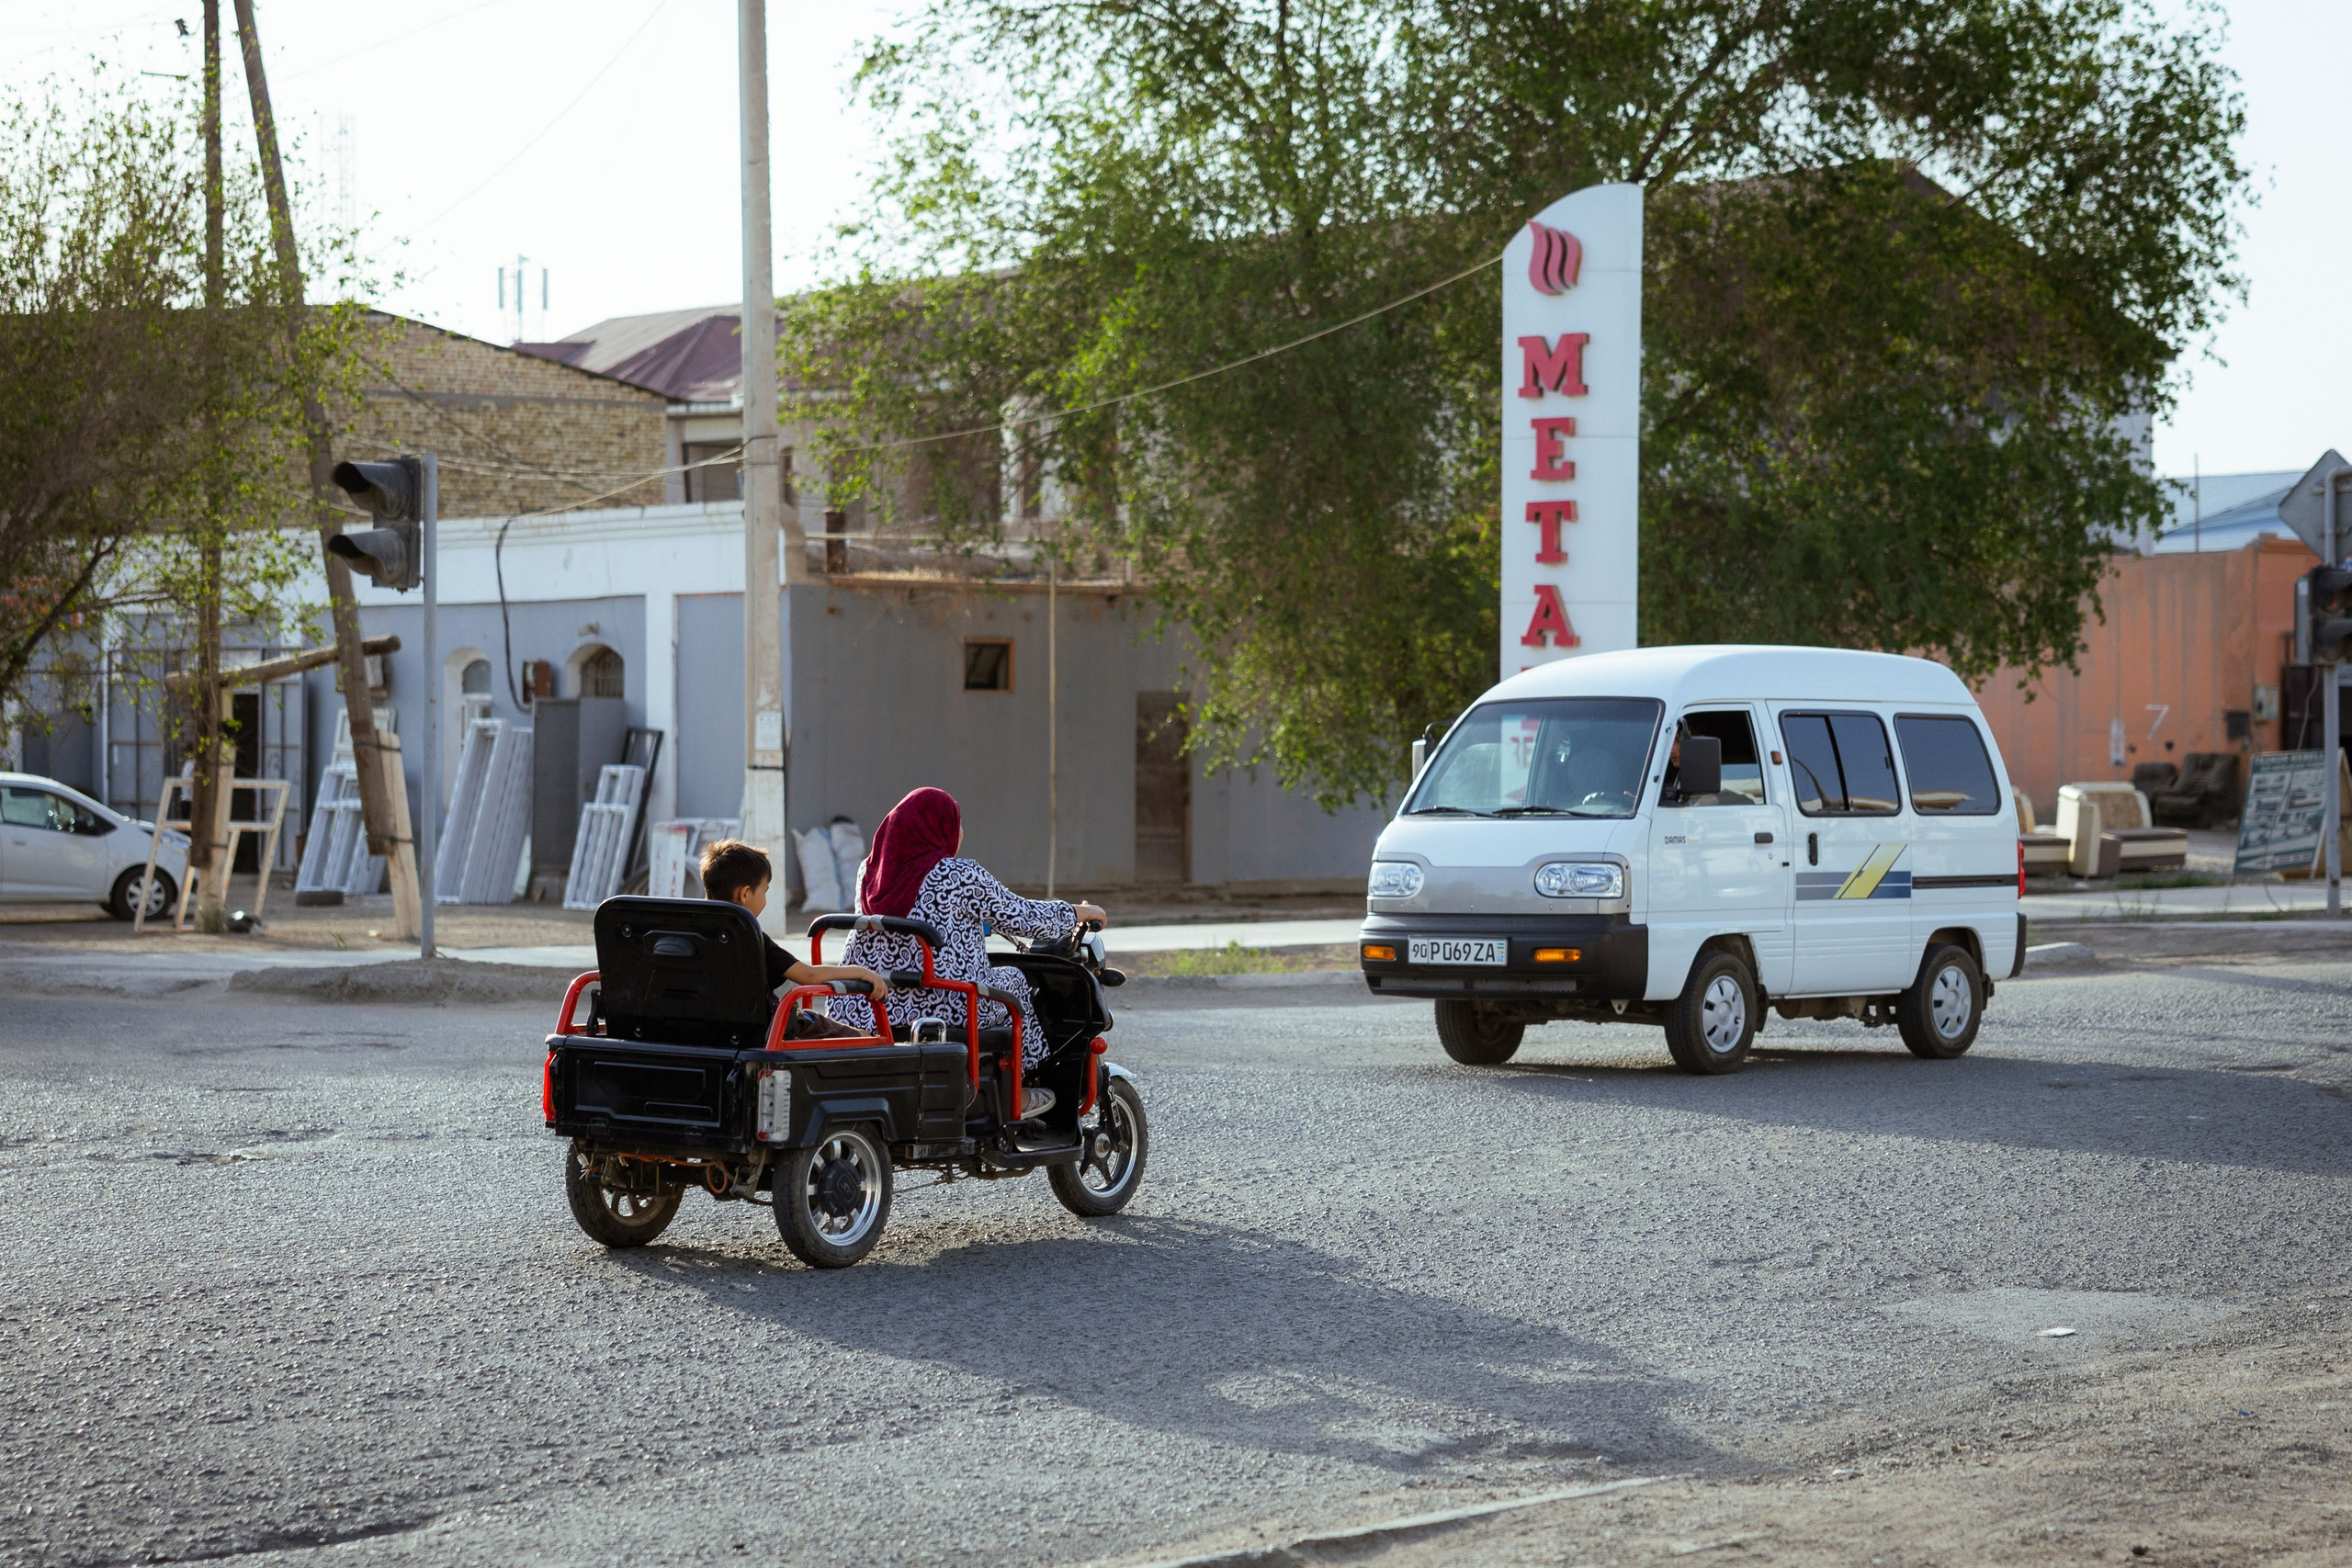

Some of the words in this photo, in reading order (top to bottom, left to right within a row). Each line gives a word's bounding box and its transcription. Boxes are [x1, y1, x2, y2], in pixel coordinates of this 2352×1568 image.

[1517, 332, 1589, 673] META
[2145, 703, 2169, 741] 7
[1664, 835, 1687, 845] DAMAS
[1412, 943, 1427, 958] 90
